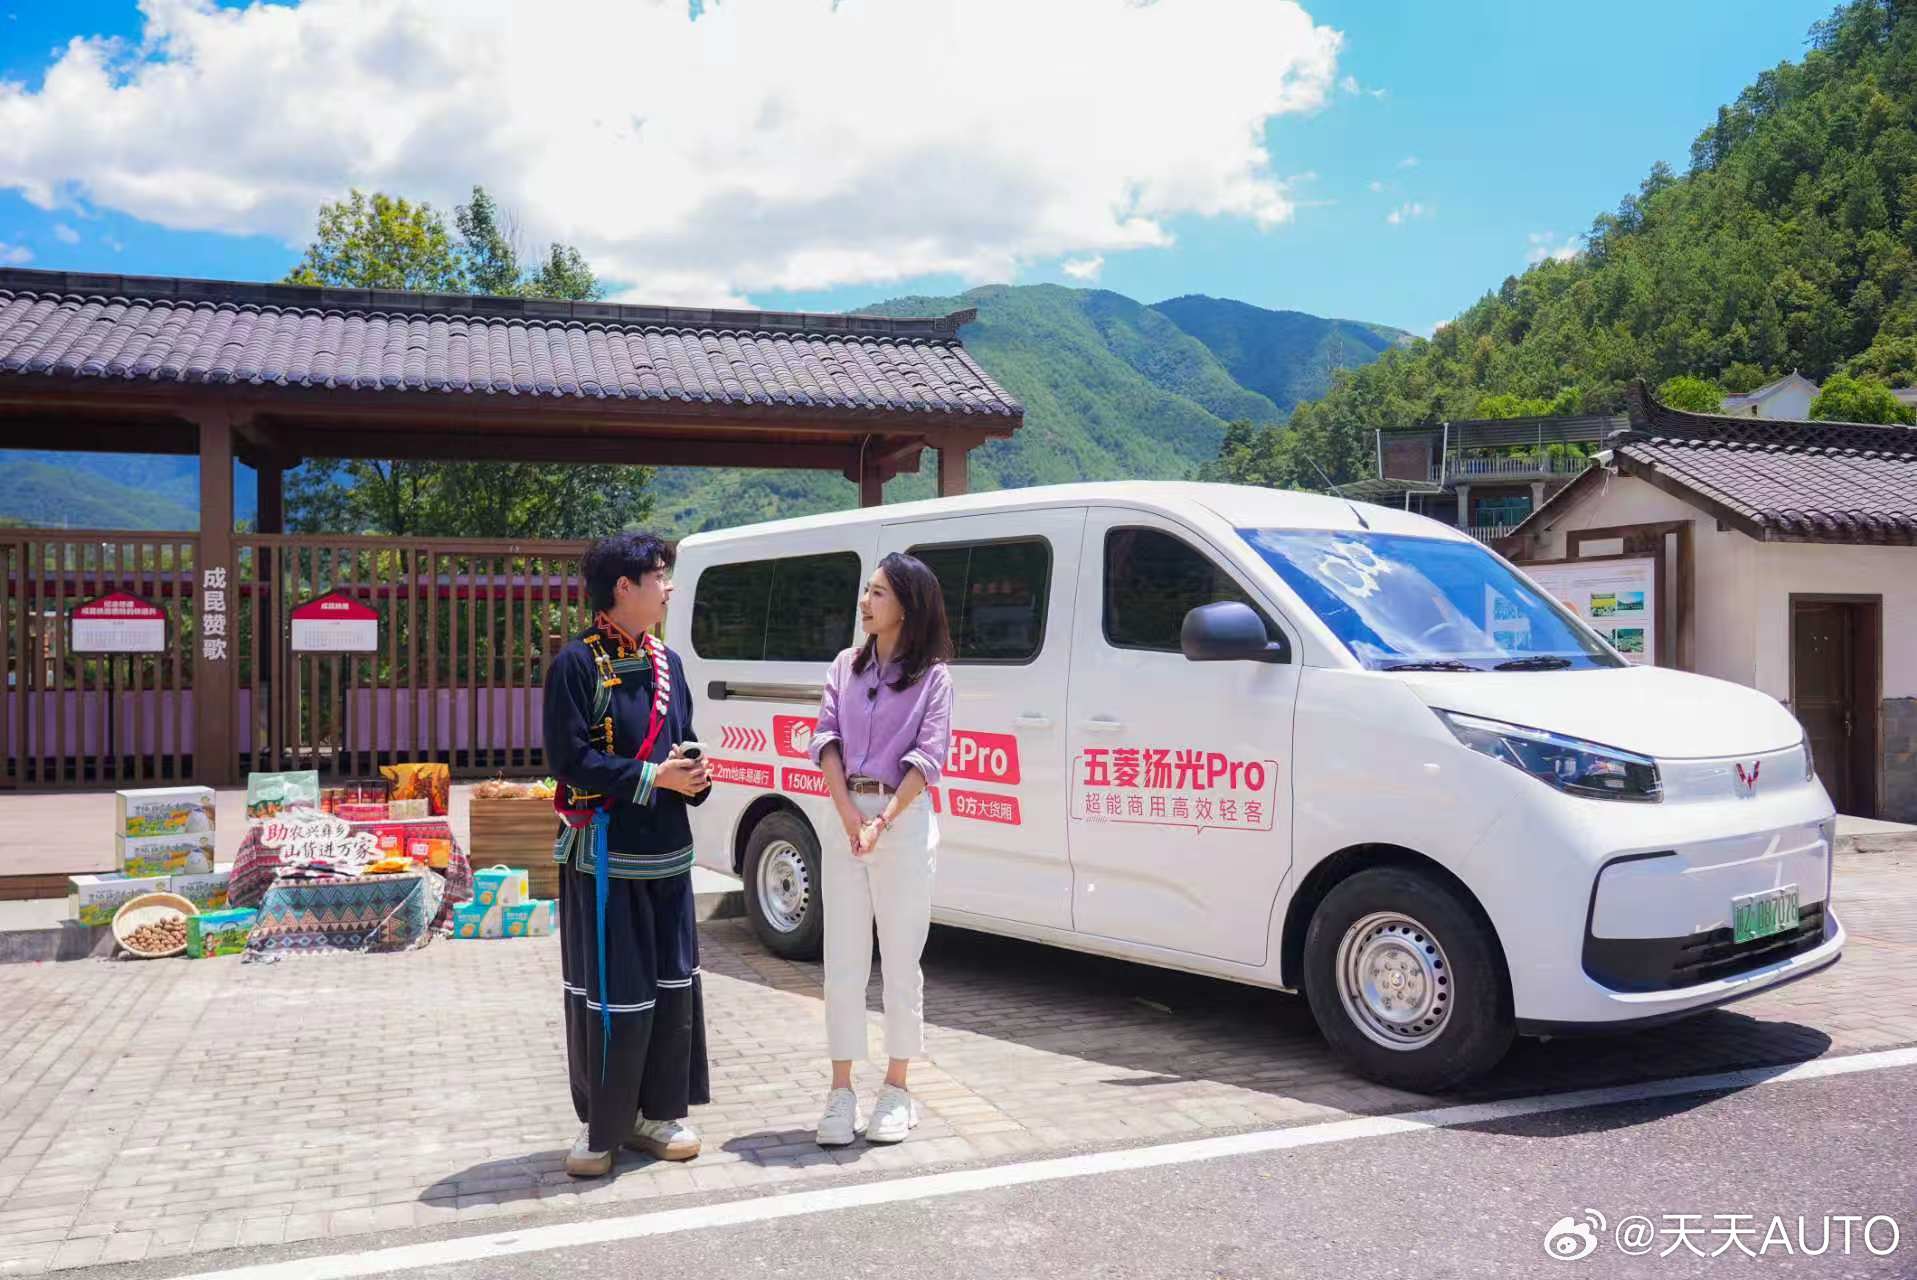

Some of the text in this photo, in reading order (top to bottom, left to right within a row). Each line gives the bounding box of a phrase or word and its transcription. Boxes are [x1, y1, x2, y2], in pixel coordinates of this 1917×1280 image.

[203, 566, 227, 660] 成昆赞歌
[787, 772, 830, 793] 150kW
[1083, 747, 1265, 791] 五菱扬光Pro
[956, 796, 1012, 820] 9方大货厢
[1085, 792, 1264, 823] 超能商用高效轻客
[284, 840, 370, 859] 山货进万家
